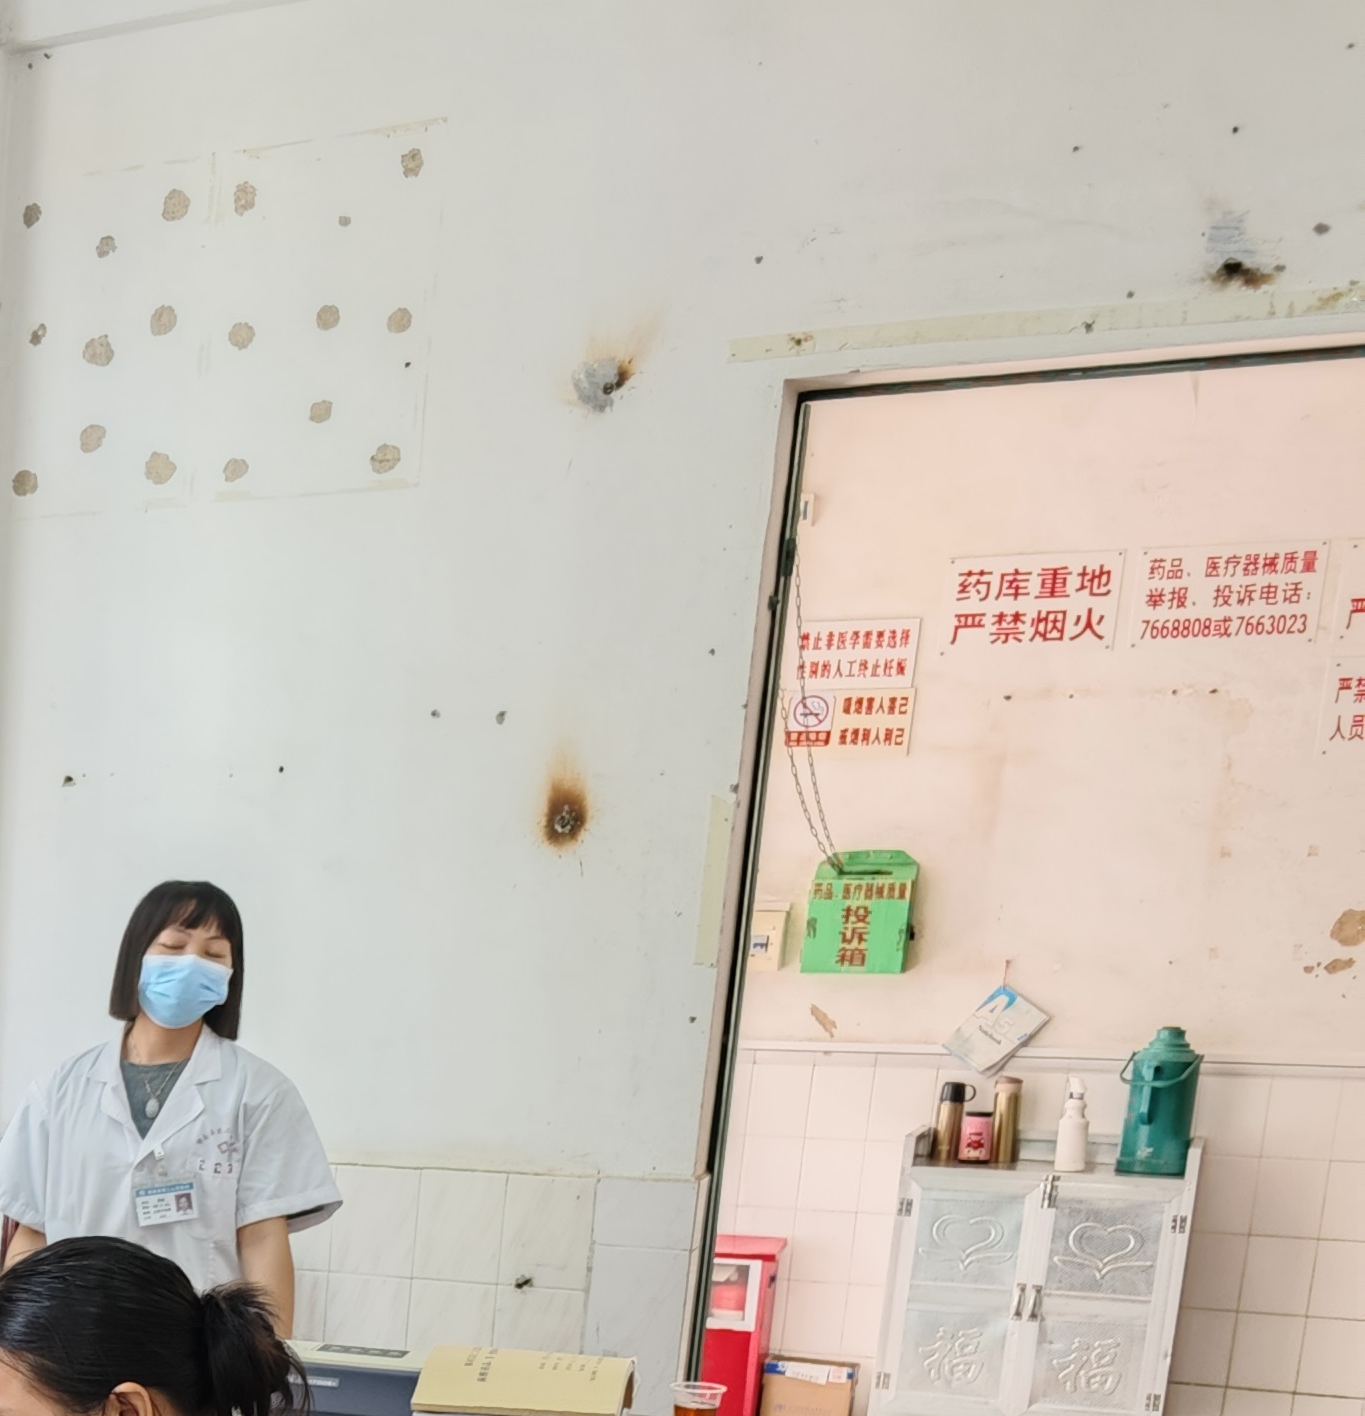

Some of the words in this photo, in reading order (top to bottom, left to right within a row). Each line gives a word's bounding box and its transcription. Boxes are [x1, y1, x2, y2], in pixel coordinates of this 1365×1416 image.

[955, 564, 1112, 602] 药库重地
[1147, 551, 1318, 581] 药品、医疗器械质量
[950, 606, 1106, 645] 严禁烟火
[1140, 613, 1308, 641] 7668808或7663023
[835, 905, 872, 967] 投诉箱
[919, 1326, 984, 1388] 福
[1052, 1337, 1122, 1396] 福
